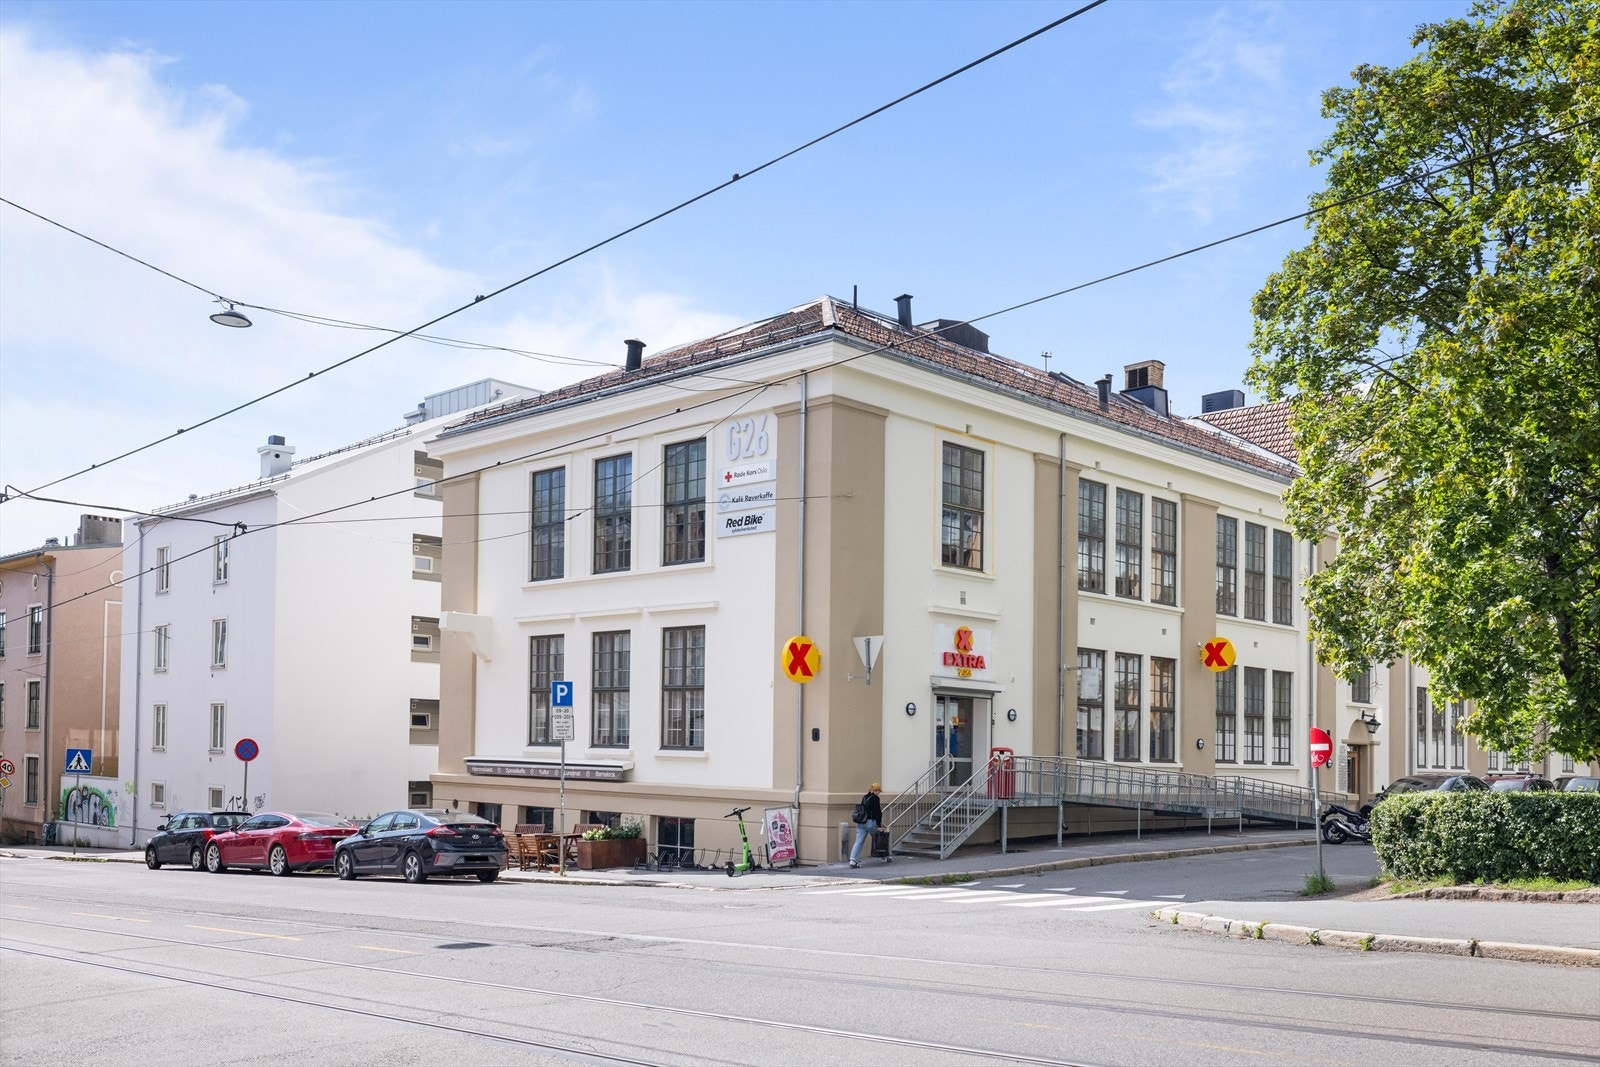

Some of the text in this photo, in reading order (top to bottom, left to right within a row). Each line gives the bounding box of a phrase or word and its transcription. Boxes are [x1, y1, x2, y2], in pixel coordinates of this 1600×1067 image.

[726, 414, 768, 461] G26
[734, 471, 746, 479] Røde
[744, 491, 773, 502] Røverkaffe
[725, 514, 763, 528] Red Bike
[943, 652, 987, 669] EXTRA
[557, 684, 568, 703] P
[1, 762, 13, 773] 40
